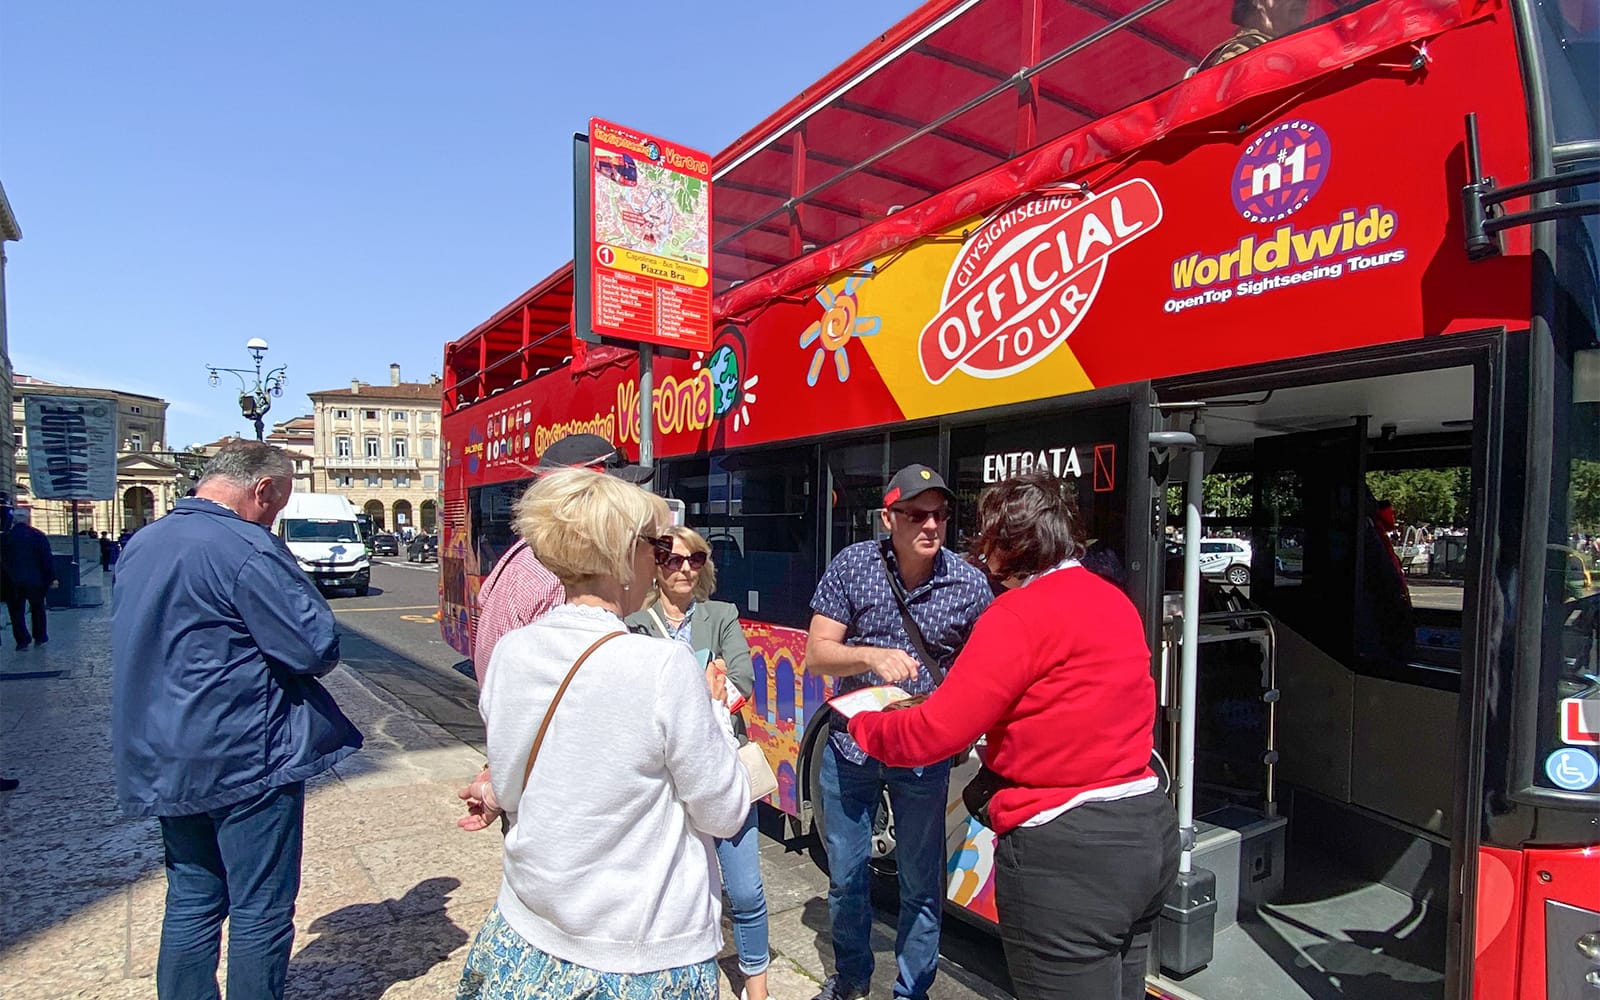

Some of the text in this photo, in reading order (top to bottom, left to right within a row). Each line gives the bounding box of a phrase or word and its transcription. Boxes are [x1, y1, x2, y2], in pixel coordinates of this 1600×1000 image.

[1245, 121, 1316, 155] Operador
[665, 147, 709, 175] Verona
[1243, 195, 1309, 223] Operator
[601, 248, 609, 263] 1
[957, 193, 1073, 288] CITYSIGHTSEEING
[1172, 207, 1396, 290] Worldwide
[641, 263, 685, 281] Piazza Bra
[938, 196, 1143, 360] OFFICIAL
[1164, 250, 1405, 312] OpenTop Sightseeing Tours
[996, 284, 1088, 362] TOUR
[617, 368, 714, 443] Veona
[983, 446, 1082, 484] ENTRATA
[1567, 702, 1600, 741] L
